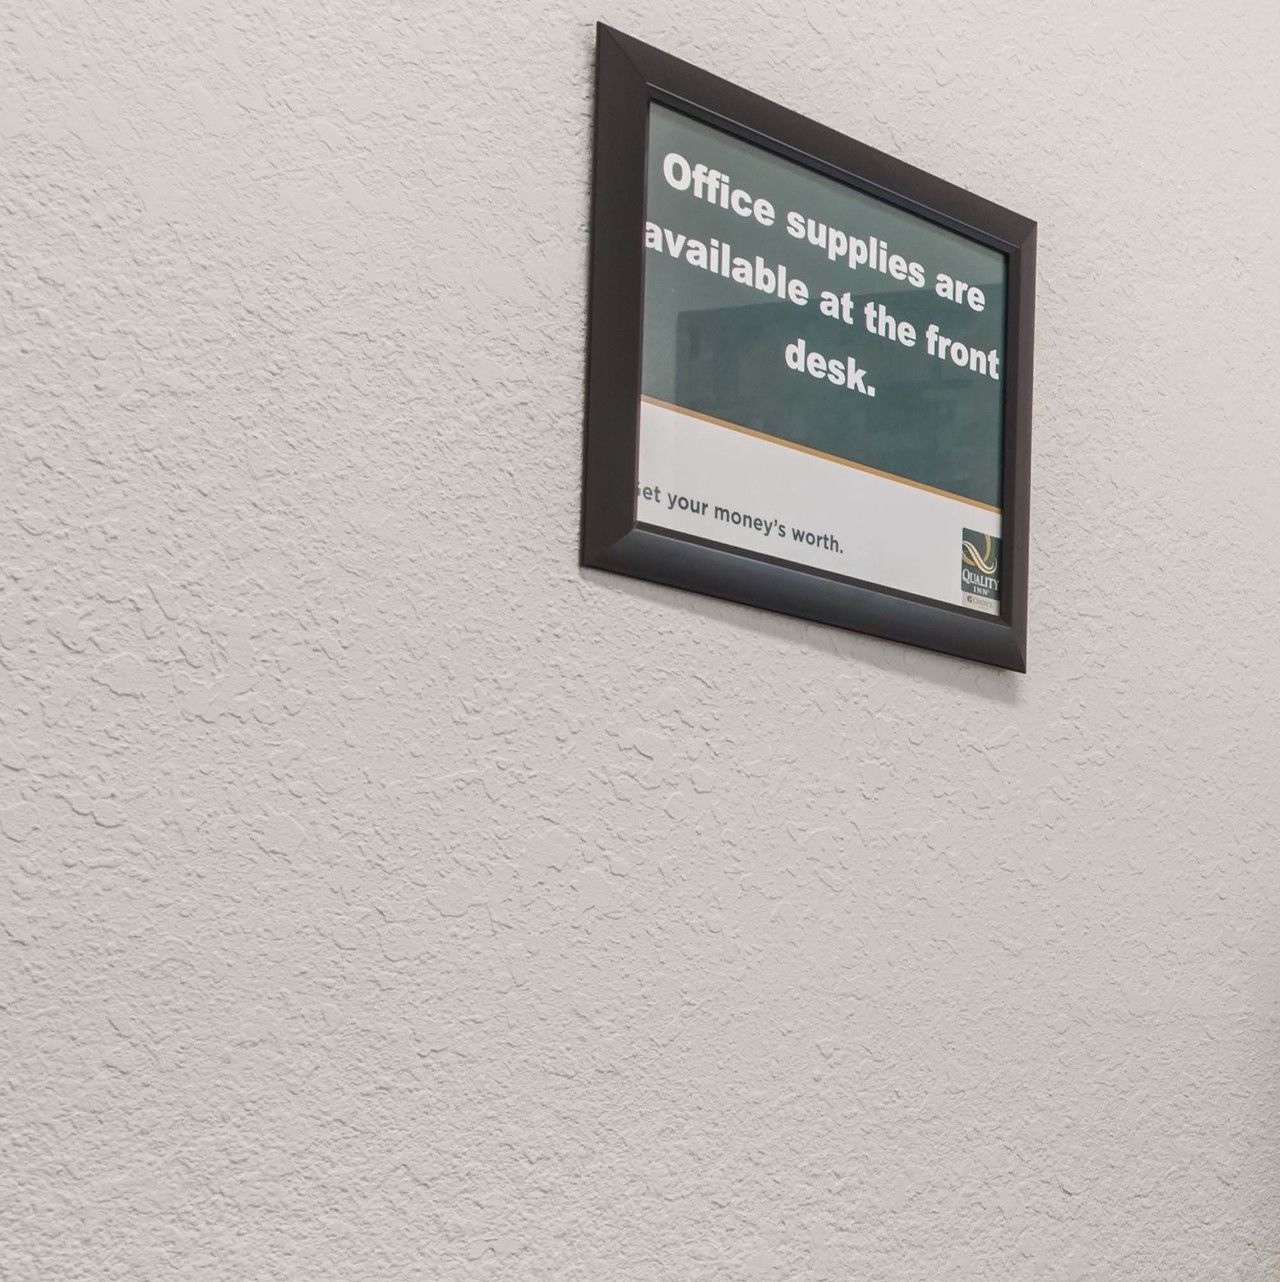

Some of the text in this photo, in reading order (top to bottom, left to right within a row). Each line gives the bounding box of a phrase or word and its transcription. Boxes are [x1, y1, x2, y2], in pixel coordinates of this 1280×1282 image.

[663, 152, 986, 312] Office supplies are
[644, 221, 1000, 380] available at the front
[784, 338, 876, 397] desk.
[637, 482, 661, 503] et
[667, 493, 709, 516] your
[792, 526, 844, 554] worth.
[962, 568, 1000, 591] QUALITY
[973, 585, 988, 596] INN
